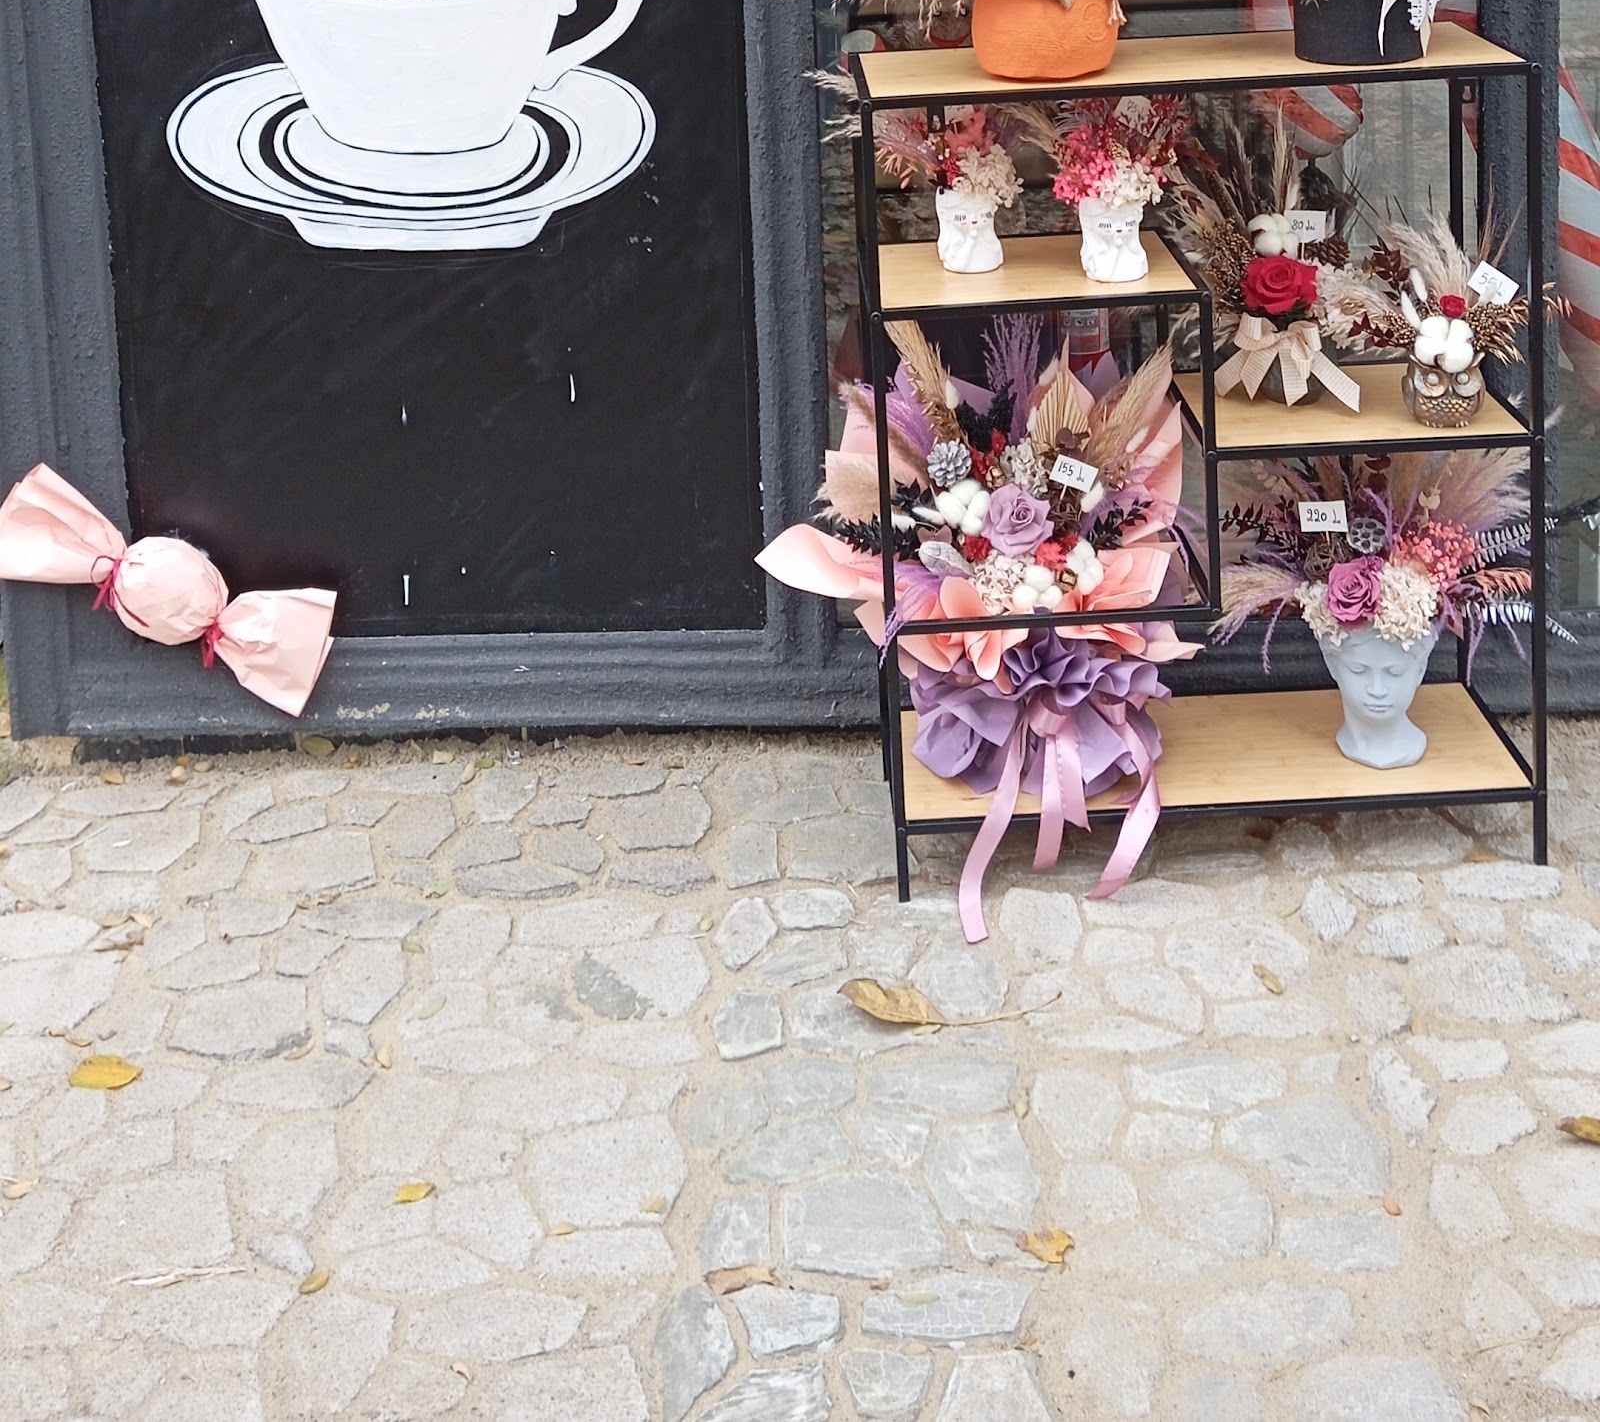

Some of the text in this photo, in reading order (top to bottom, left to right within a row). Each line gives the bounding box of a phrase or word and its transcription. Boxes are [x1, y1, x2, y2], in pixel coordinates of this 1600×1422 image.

[1291, 219, 1304, 231] 80
[1057, 461, 1075, 477] 155
[1306, 508, 1328, 523] 220
